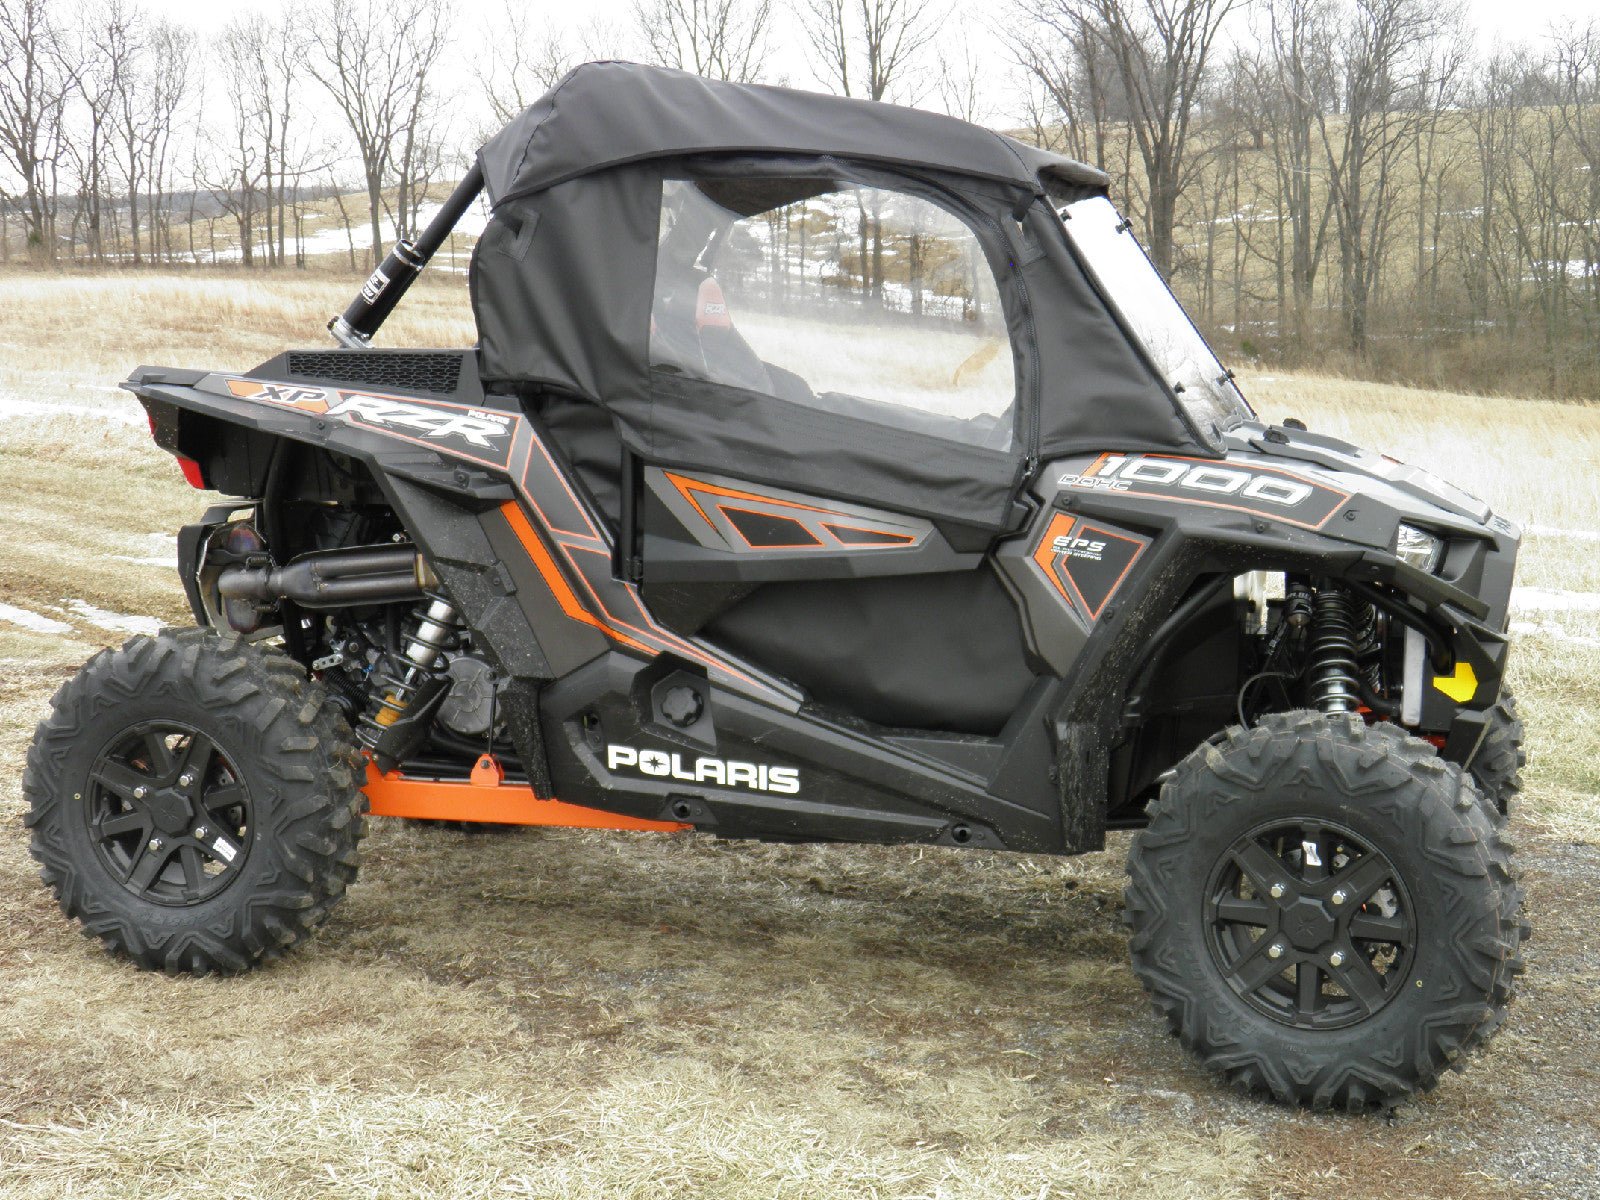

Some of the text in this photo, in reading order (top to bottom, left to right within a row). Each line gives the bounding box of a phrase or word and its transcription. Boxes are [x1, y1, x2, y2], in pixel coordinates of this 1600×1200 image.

[249, 384, 328, 403] XP
[325, 395, 507, 450] RZR
[468, 410, 510, 425] POLARIS
[1057, 474, 1133, 491] DOHC
[1098, 456, 1313, 506] 1000
[1053, 536, 1107, 552] EPS
[607, 744, 800, 794] POLARIS
